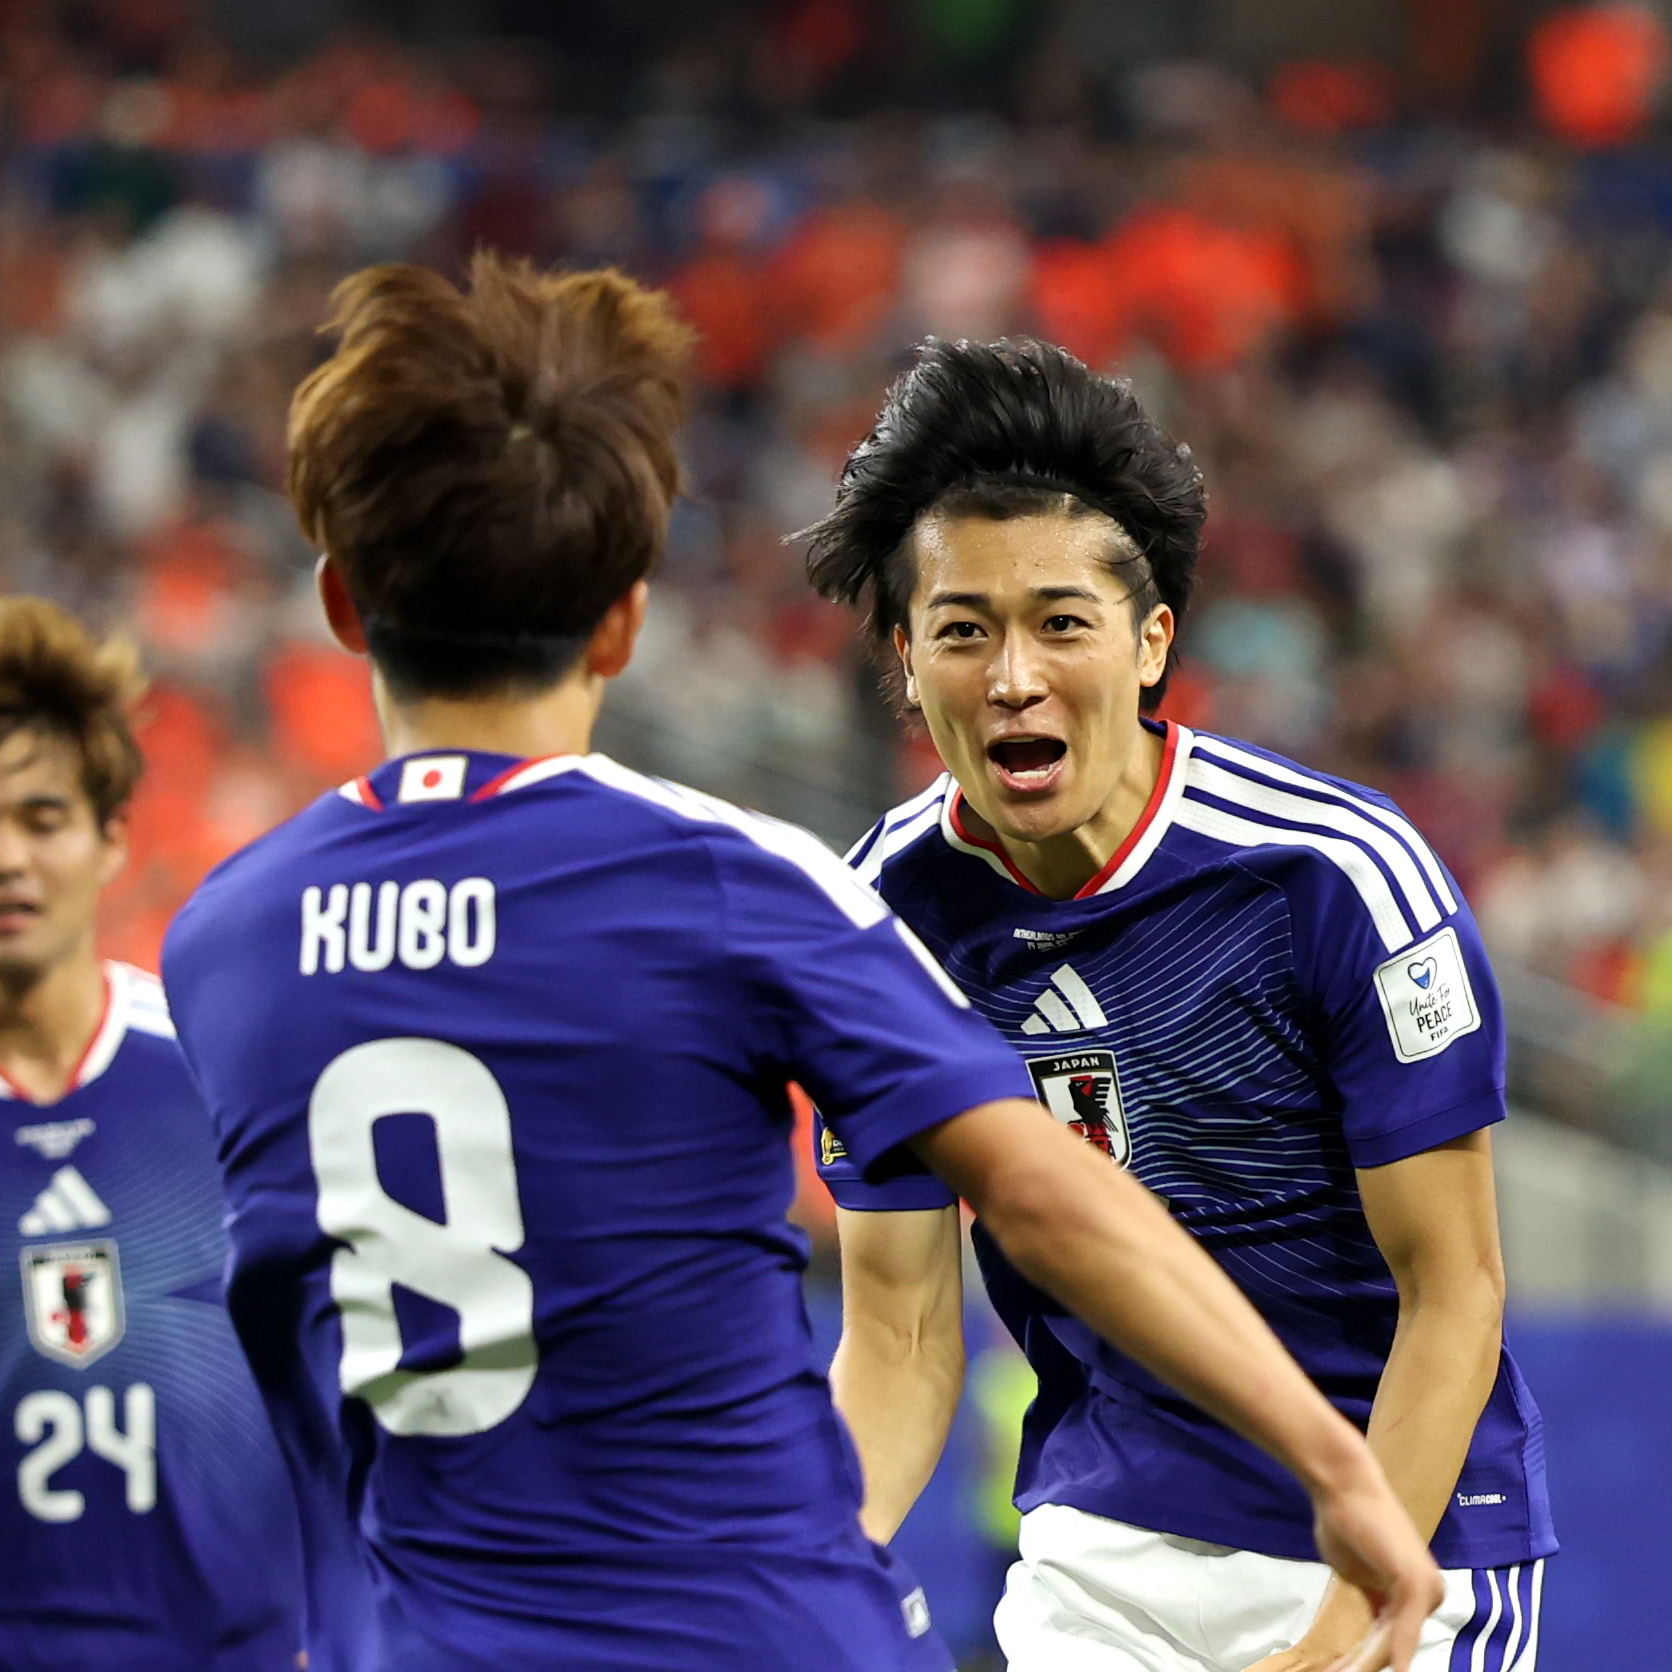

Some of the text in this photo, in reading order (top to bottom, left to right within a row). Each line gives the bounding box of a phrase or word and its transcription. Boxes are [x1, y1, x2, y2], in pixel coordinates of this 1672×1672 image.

[299, 877, 497, 975] KUBO
[1416, 1001, 1453, 1033] PEACE
[1430, 1025, 1449, 1041] FIFA
[1053, 1056, 1100, 1072] JAPAN
[308, 1037, 538, 1436] 8
[14, 1382, 157, 1524] 24
